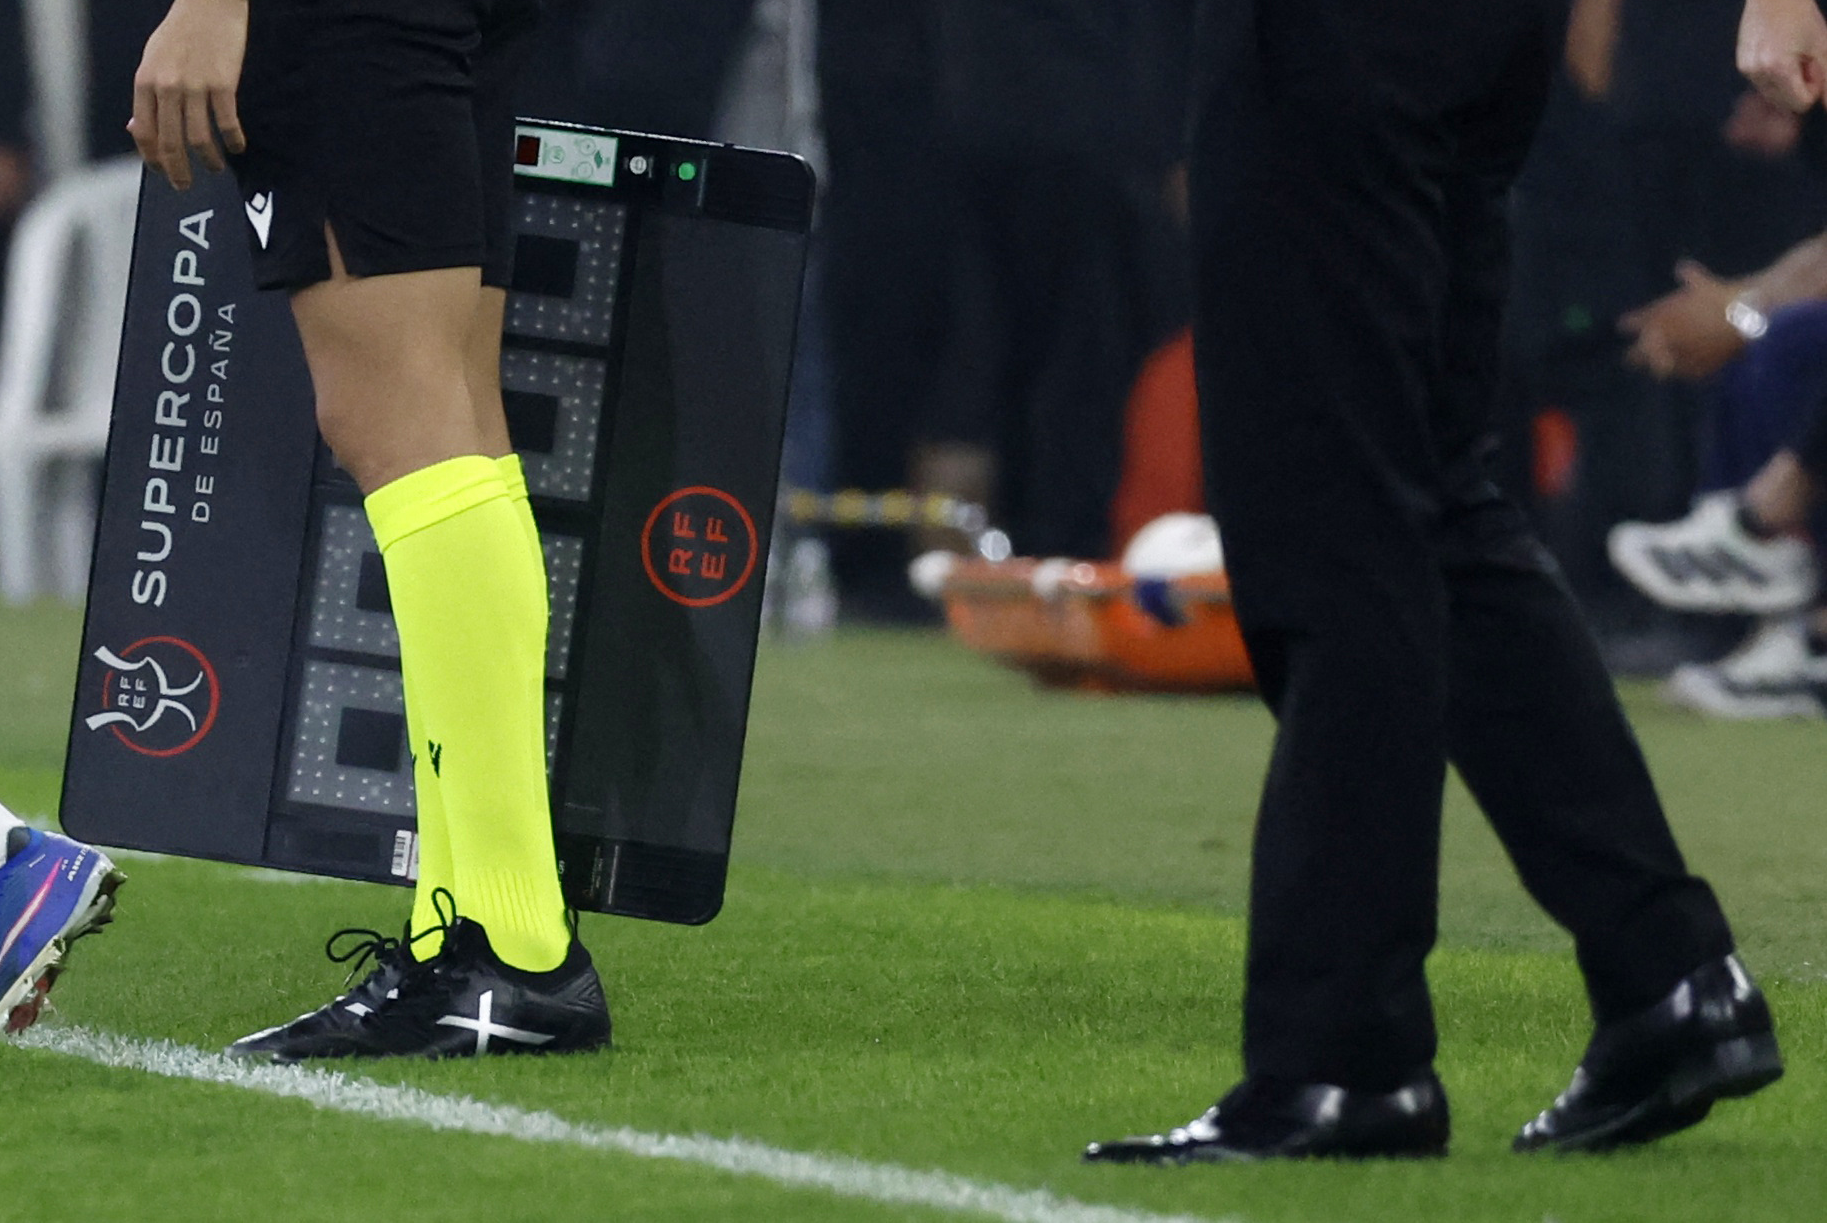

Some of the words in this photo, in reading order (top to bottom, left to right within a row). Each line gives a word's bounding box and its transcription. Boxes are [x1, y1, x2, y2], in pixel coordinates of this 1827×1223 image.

[131, 209, 215, 608] SUPERCOPA
[200, 303, 237, 456] ESPAÑA
[191, 474, 215, 523] DE
